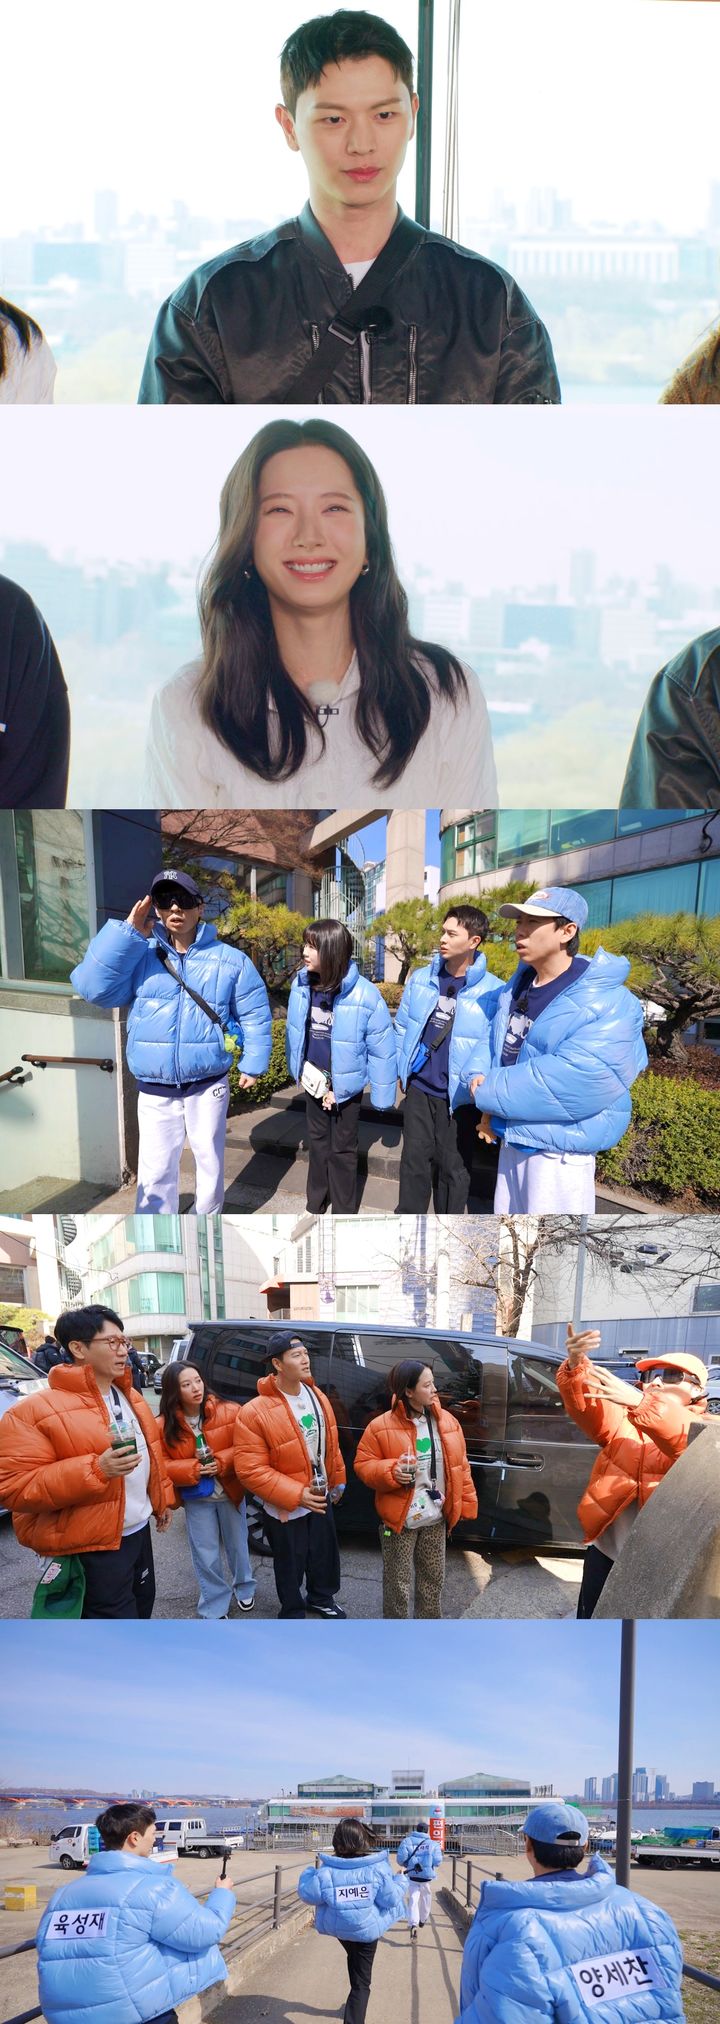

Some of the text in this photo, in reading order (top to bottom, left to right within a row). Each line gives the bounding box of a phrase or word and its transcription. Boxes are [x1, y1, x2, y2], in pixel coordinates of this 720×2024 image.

[338, 1886, 369, 1899] 지예은
[53, 1912, 106, 1935] 육성재
[579, 1955, 653, 1998] 양세찬
